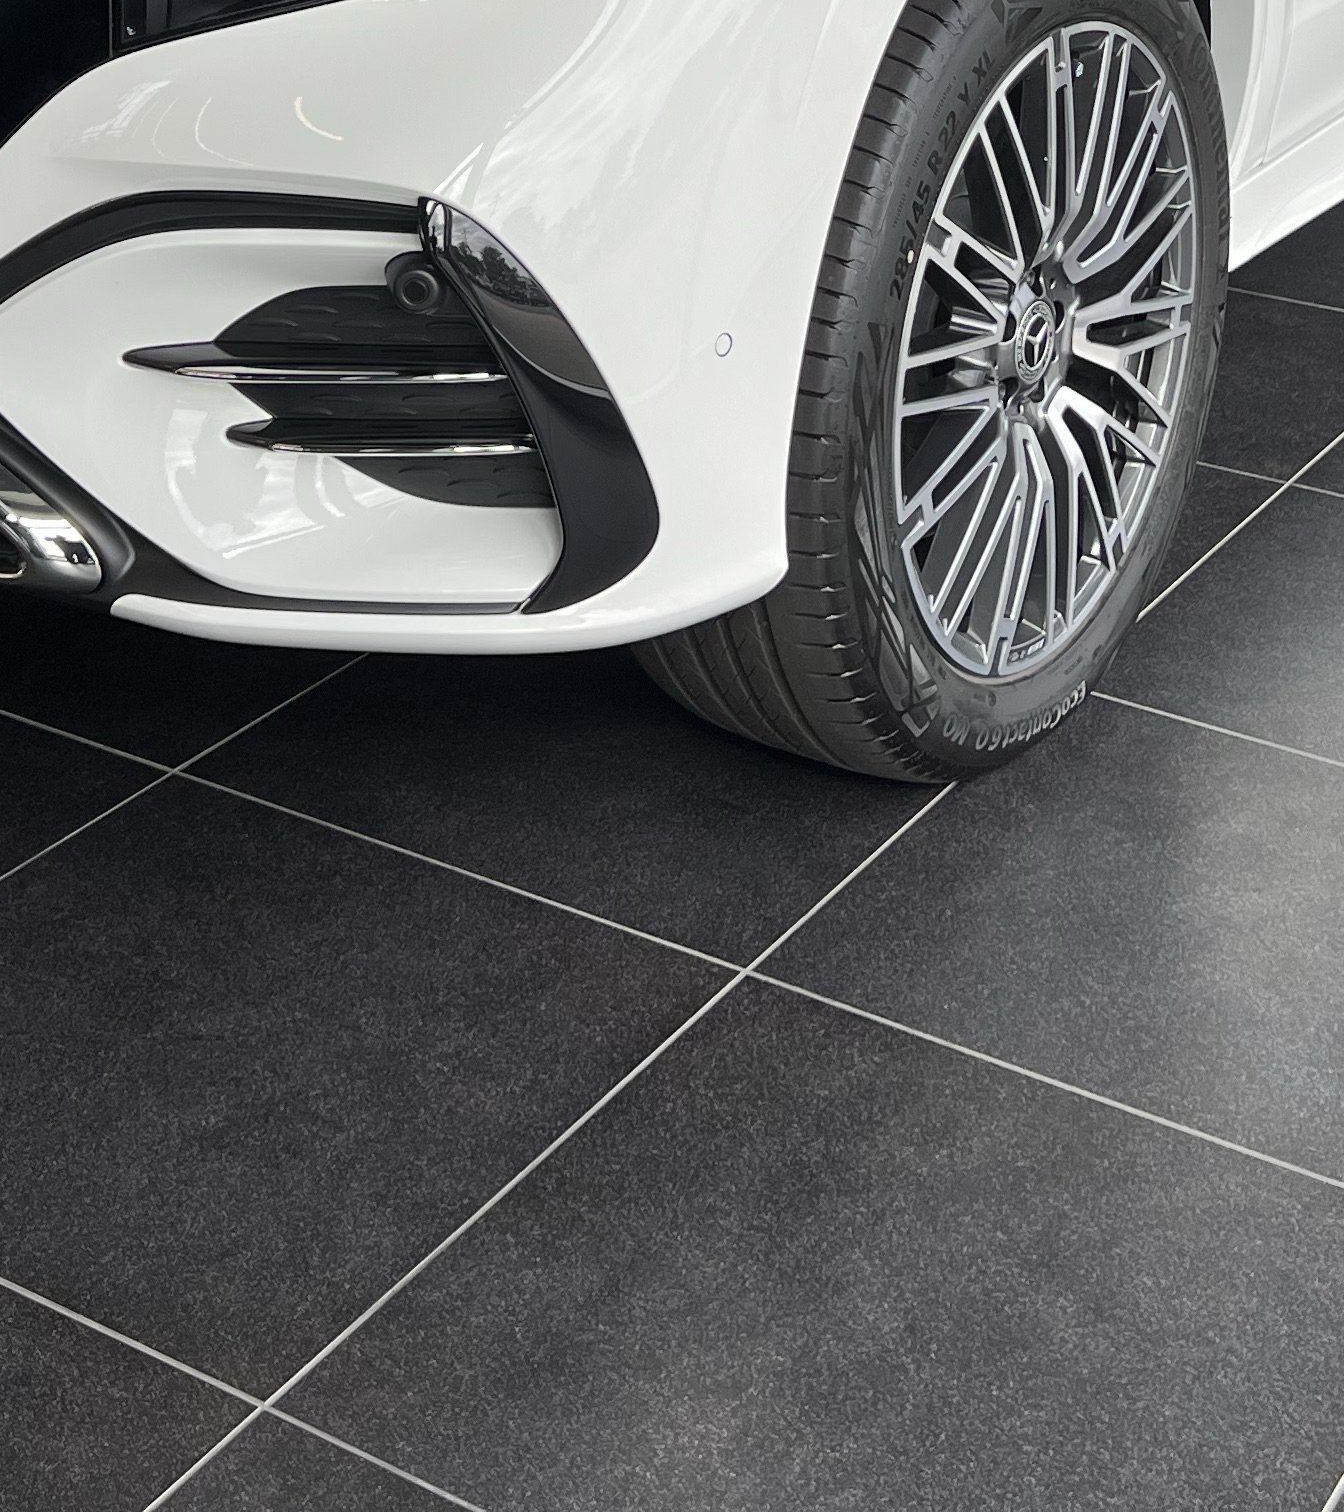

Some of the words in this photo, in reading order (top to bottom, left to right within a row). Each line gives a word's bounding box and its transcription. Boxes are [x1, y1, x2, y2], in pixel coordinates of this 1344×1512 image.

[889, 180, 931, 301] 285/45
[927, 150, 943, 176] R
[938, 110, 957, 153] 22
[971, 49, 996, 86] XL
